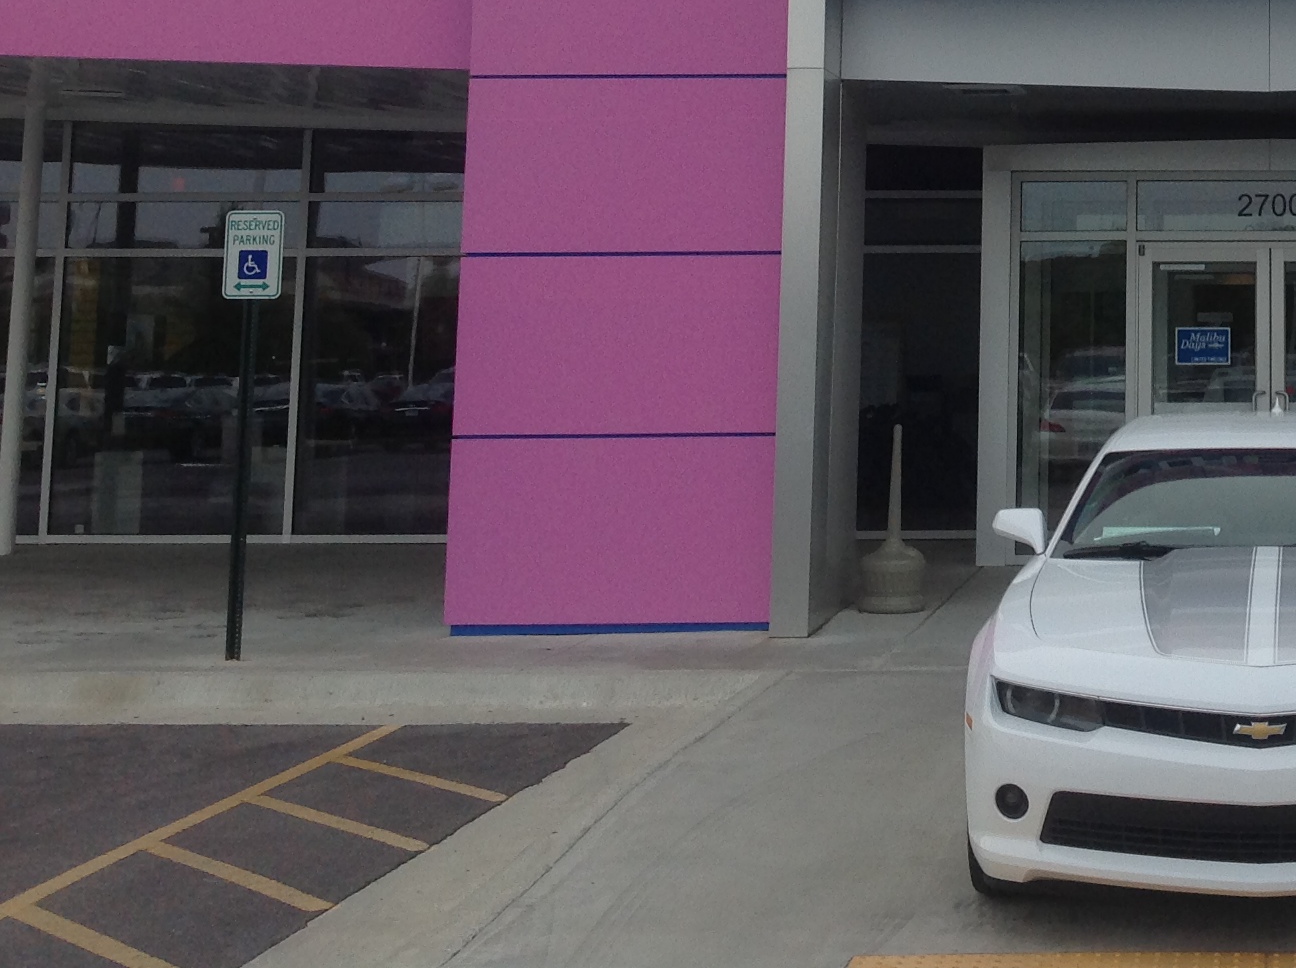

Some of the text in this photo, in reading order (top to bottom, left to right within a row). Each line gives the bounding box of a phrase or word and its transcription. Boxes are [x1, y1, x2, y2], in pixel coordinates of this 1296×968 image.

[230, 219, 280, 231] RESERVED
[232, 234, 275, 246] PARKING
[1190, 332, 1226, 342] Malibu
[1181, 339, 1207, 352] Days
